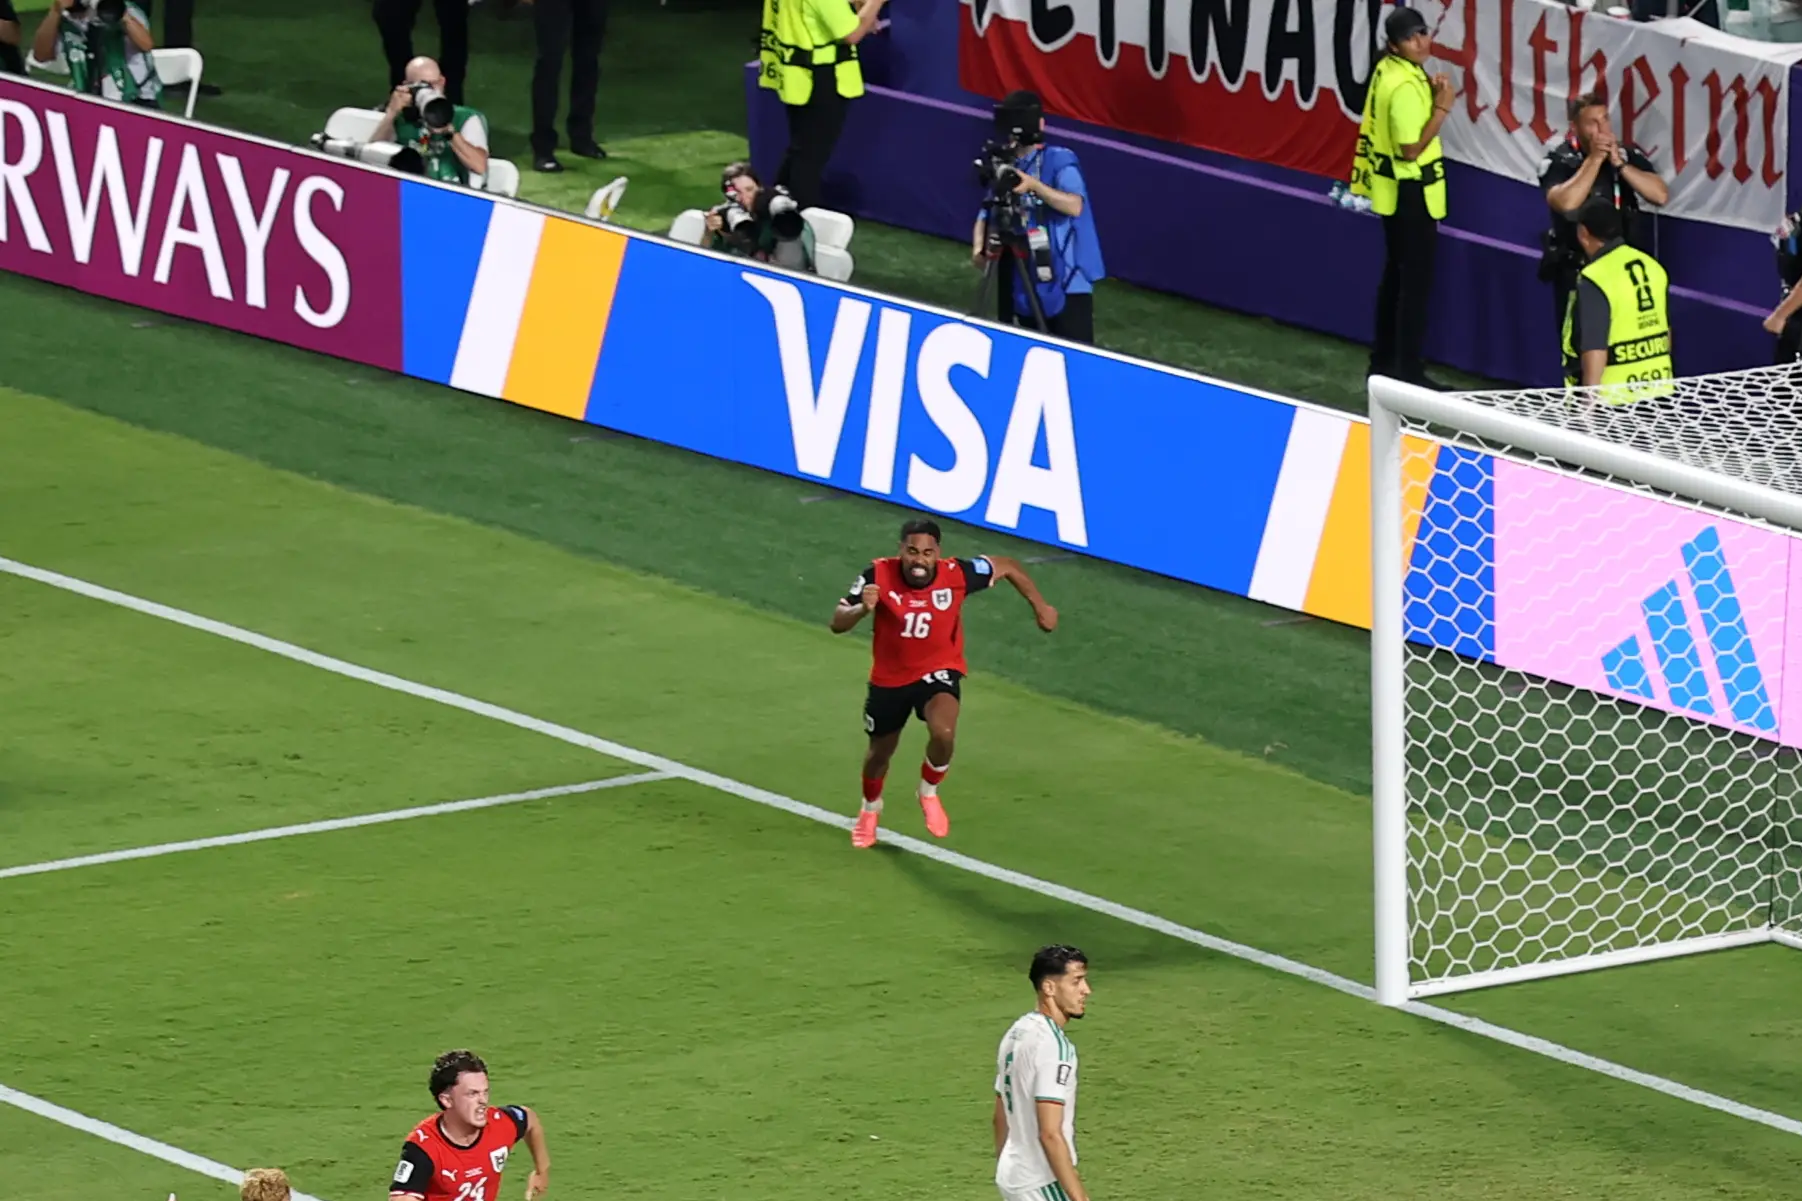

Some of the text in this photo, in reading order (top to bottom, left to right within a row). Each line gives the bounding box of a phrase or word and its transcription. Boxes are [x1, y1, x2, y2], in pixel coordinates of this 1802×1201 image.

[1430, 0, 1783, 189] Altheim
[742, 272, 1088, 547] VISA
[900, 612, 932, 638] 16
